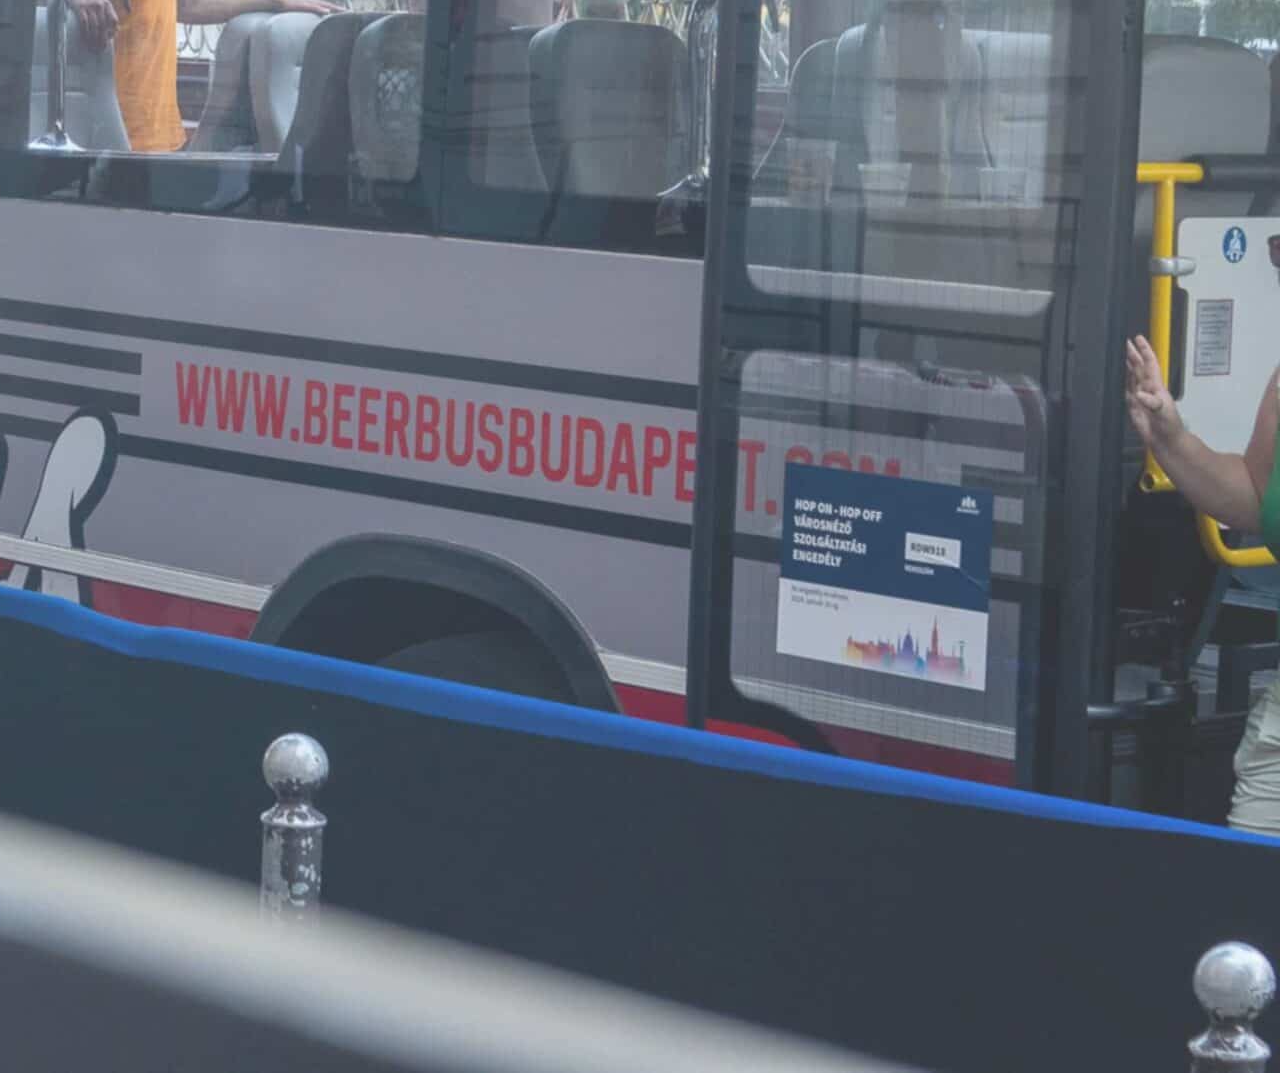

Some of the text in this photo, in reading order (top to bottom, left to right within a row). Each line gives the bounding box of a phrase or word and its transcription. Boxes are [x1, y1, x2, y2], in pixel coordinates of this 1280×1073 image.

[794, 498, 816, 512] HOP
[817, 502, 832, 515] ON
[839, 505, 861, 519] HOP
[862, 509, 883, 522] OFF
[793, 532, 867, 555] SZOLGÁLTATÁSI
[792, 548, 842, 567] ENGEDÉLY
